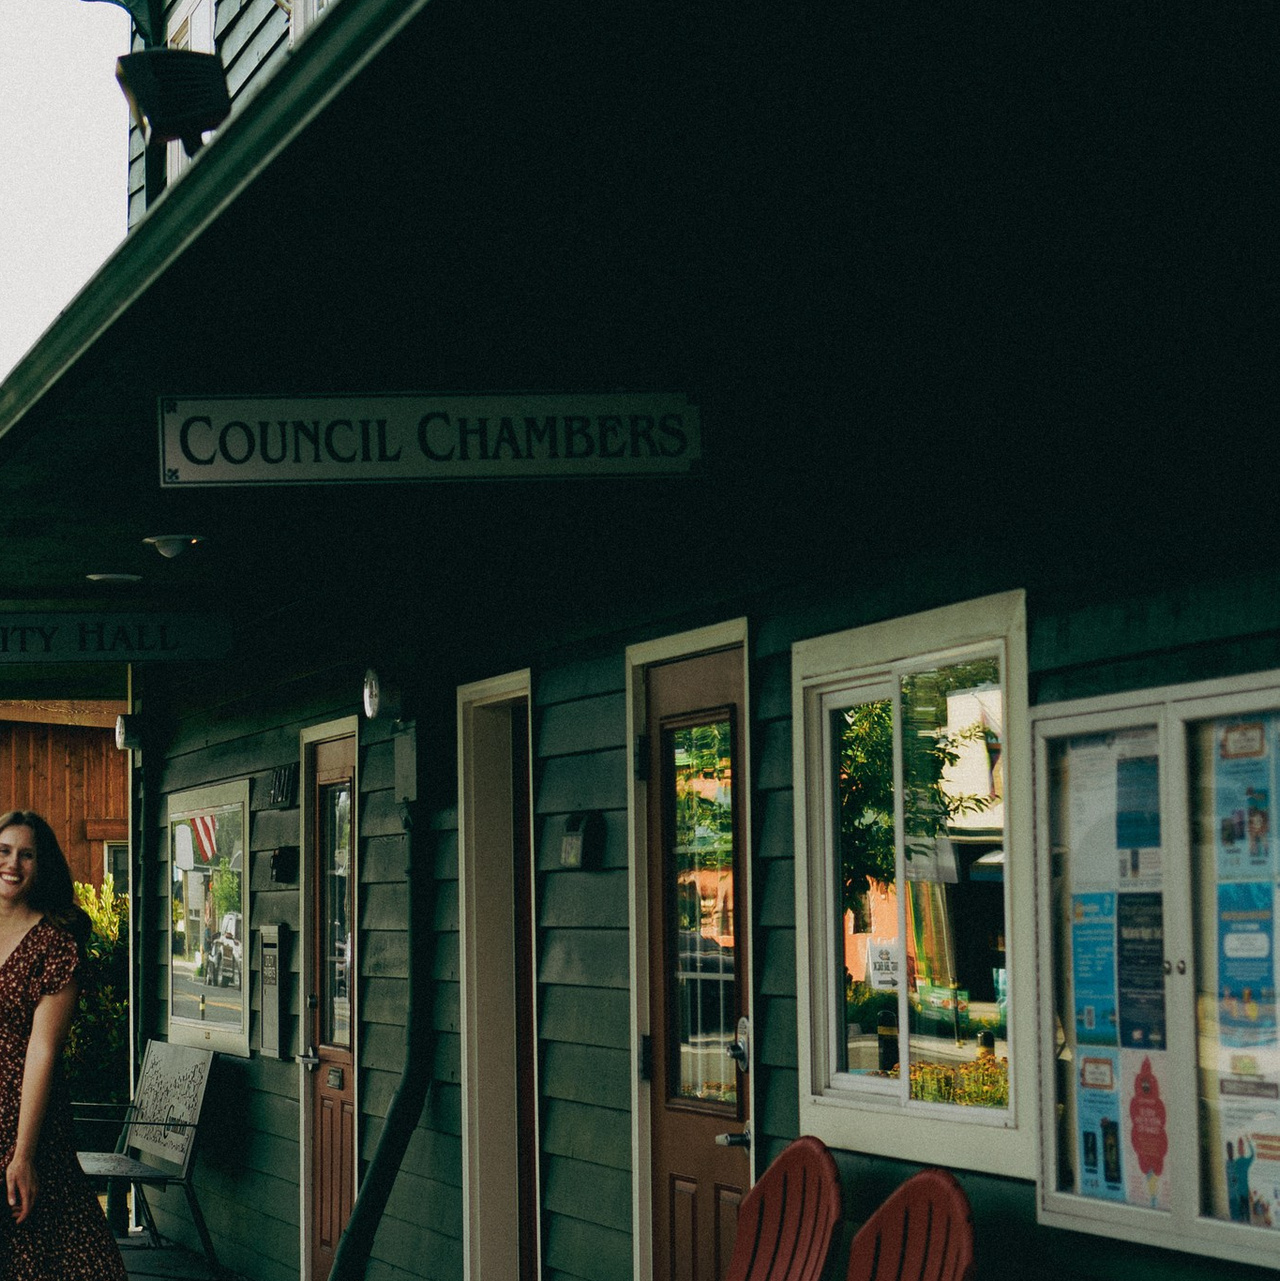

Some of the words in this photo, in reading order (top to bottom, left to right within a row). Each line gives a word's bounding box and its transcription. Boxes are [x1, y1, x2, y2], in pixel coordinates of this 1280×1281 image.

[178, 414, 402, 466] COUNCIL
[416, 410, 689, 463] CHAMBERS
[77, 621, 180, 652] HALL
